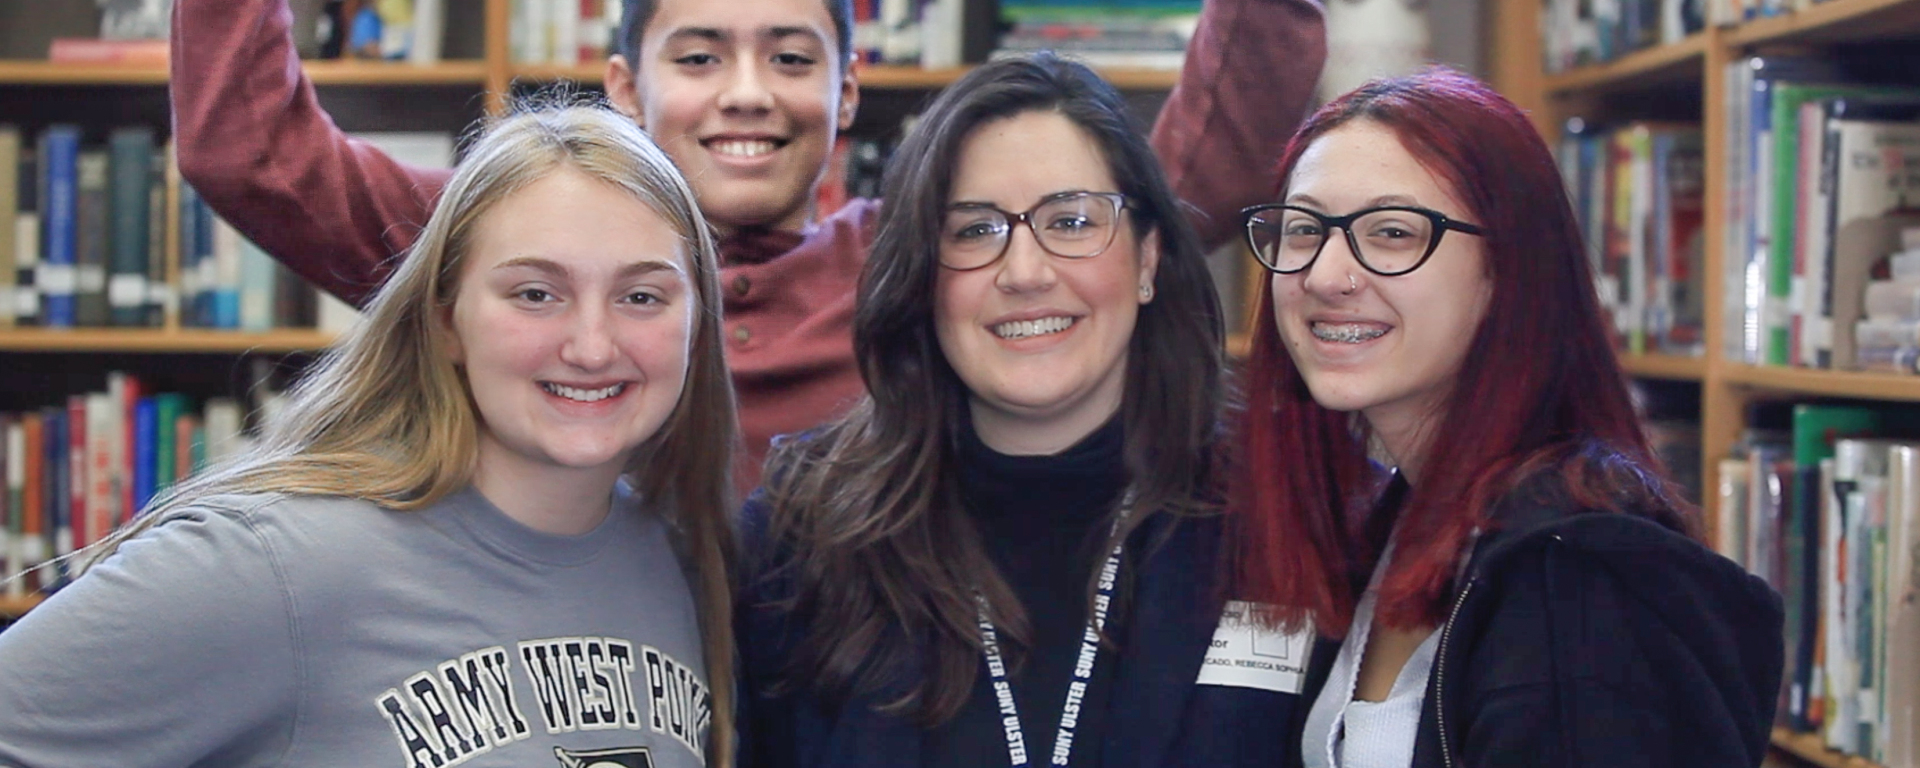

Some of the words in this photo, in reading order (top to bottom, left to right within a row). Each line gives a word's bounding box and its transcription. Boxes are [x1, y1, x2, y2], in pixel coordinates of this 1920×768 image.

[1074, 640, 1100, 679] SUNY
[374, 645, 531, 768] ARMY
[517, 636, 640, 735] WEST
[993, 681, 1017, 715] SUNY
[1060, 681, 1088, 729] ULSTER
[1003, 715, 1028, 766] ULSTER
[1051, 728, 1075, 766] SUNY
